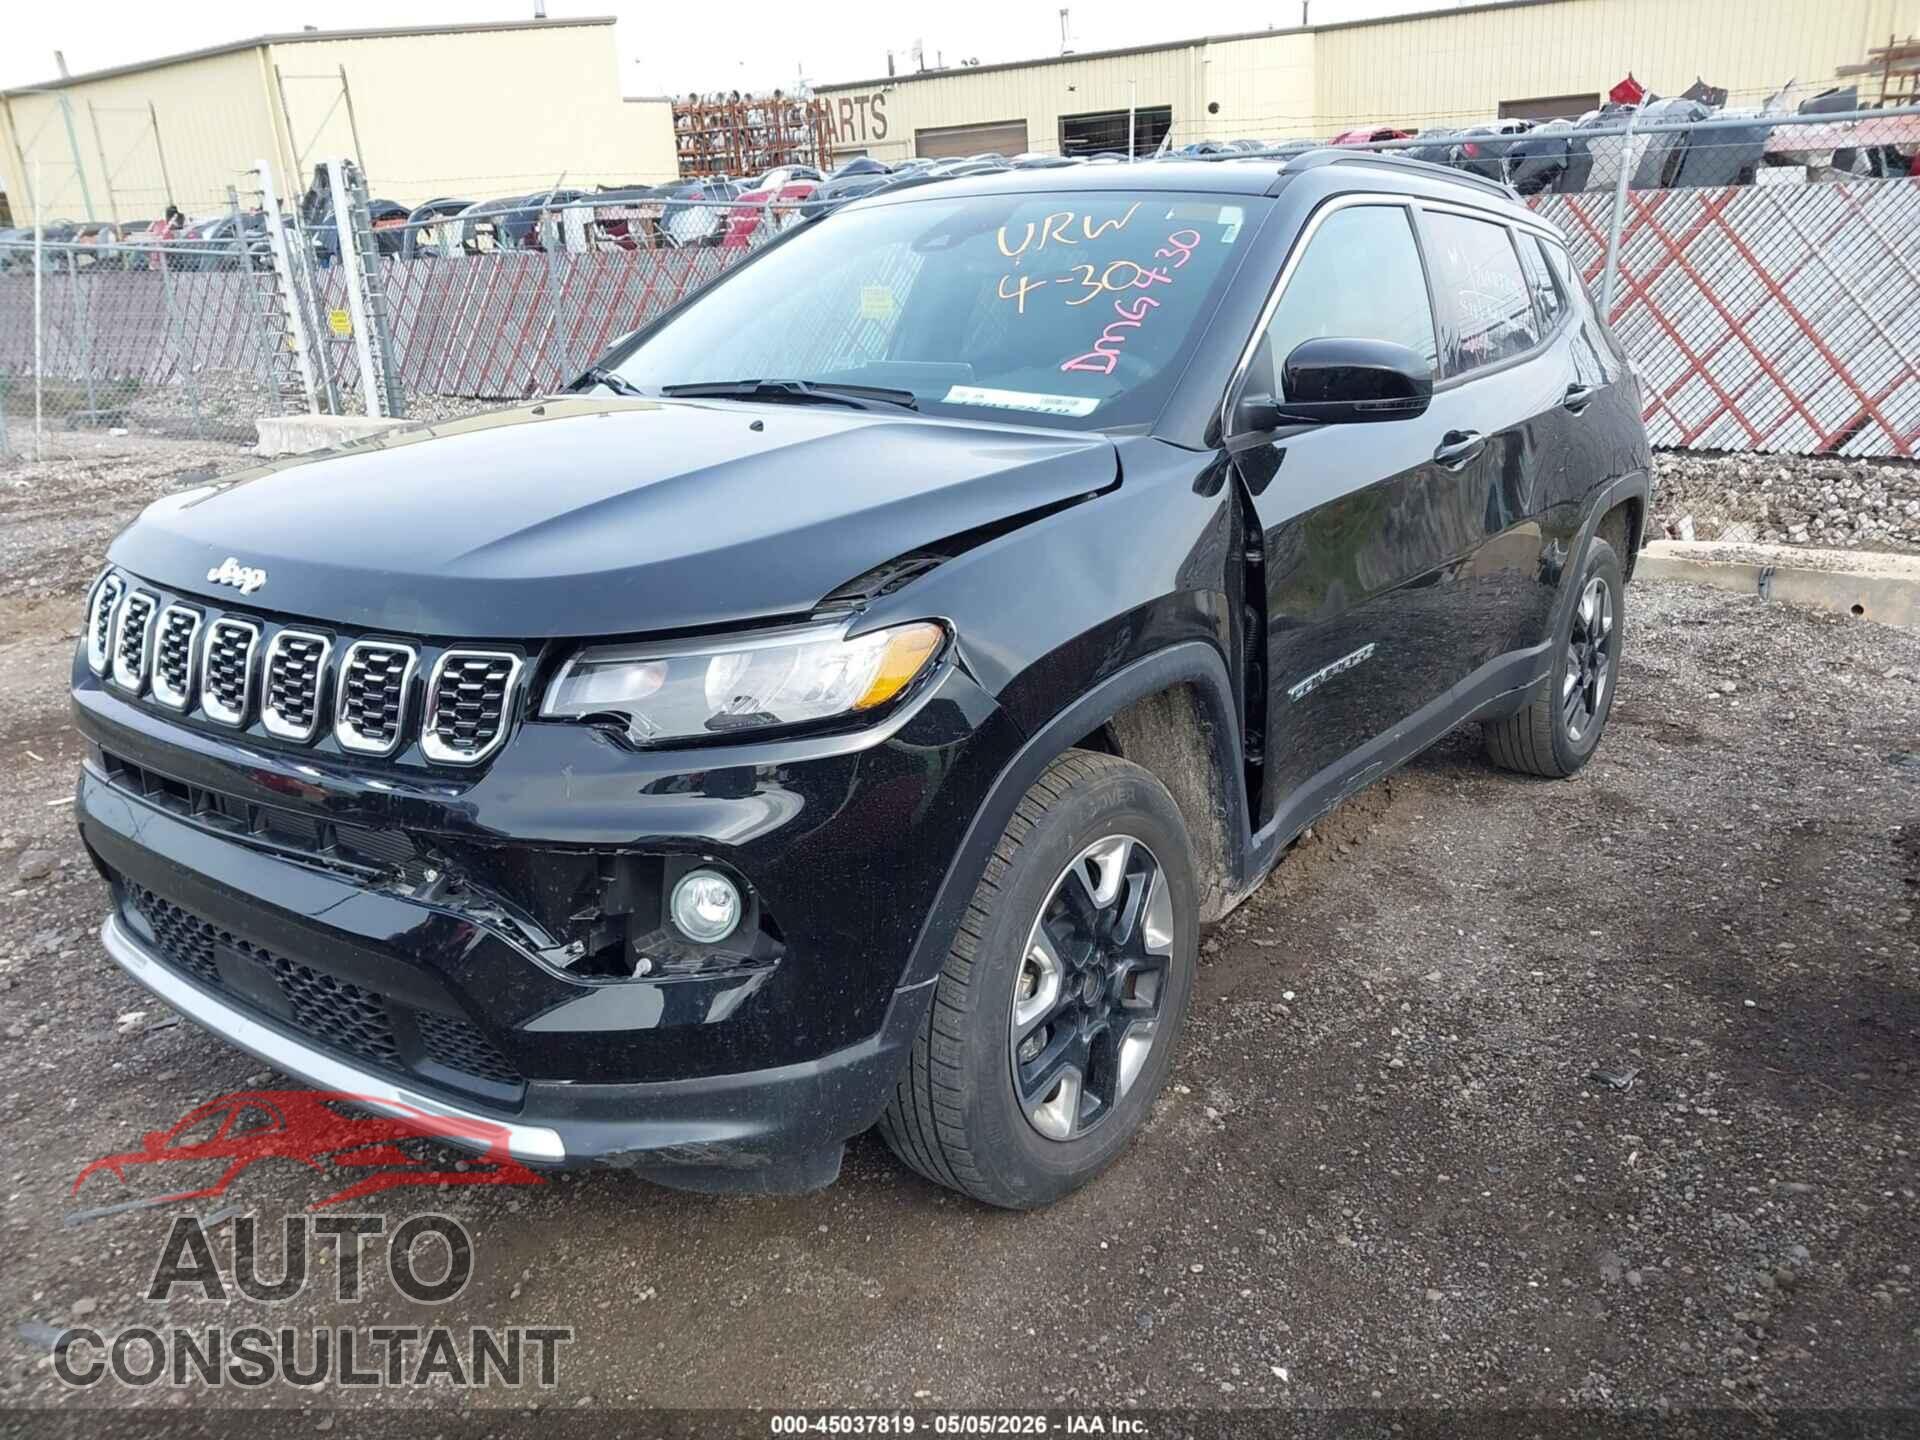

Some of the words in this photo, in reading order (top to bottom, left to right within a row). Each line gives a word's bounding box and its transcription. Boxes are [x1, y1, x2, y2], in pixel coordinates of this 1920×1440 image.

[814, 93, 888, 143] ARTS
[997, 201, 1142, 257] URW
[206, 557, 267, 597] Jeep
